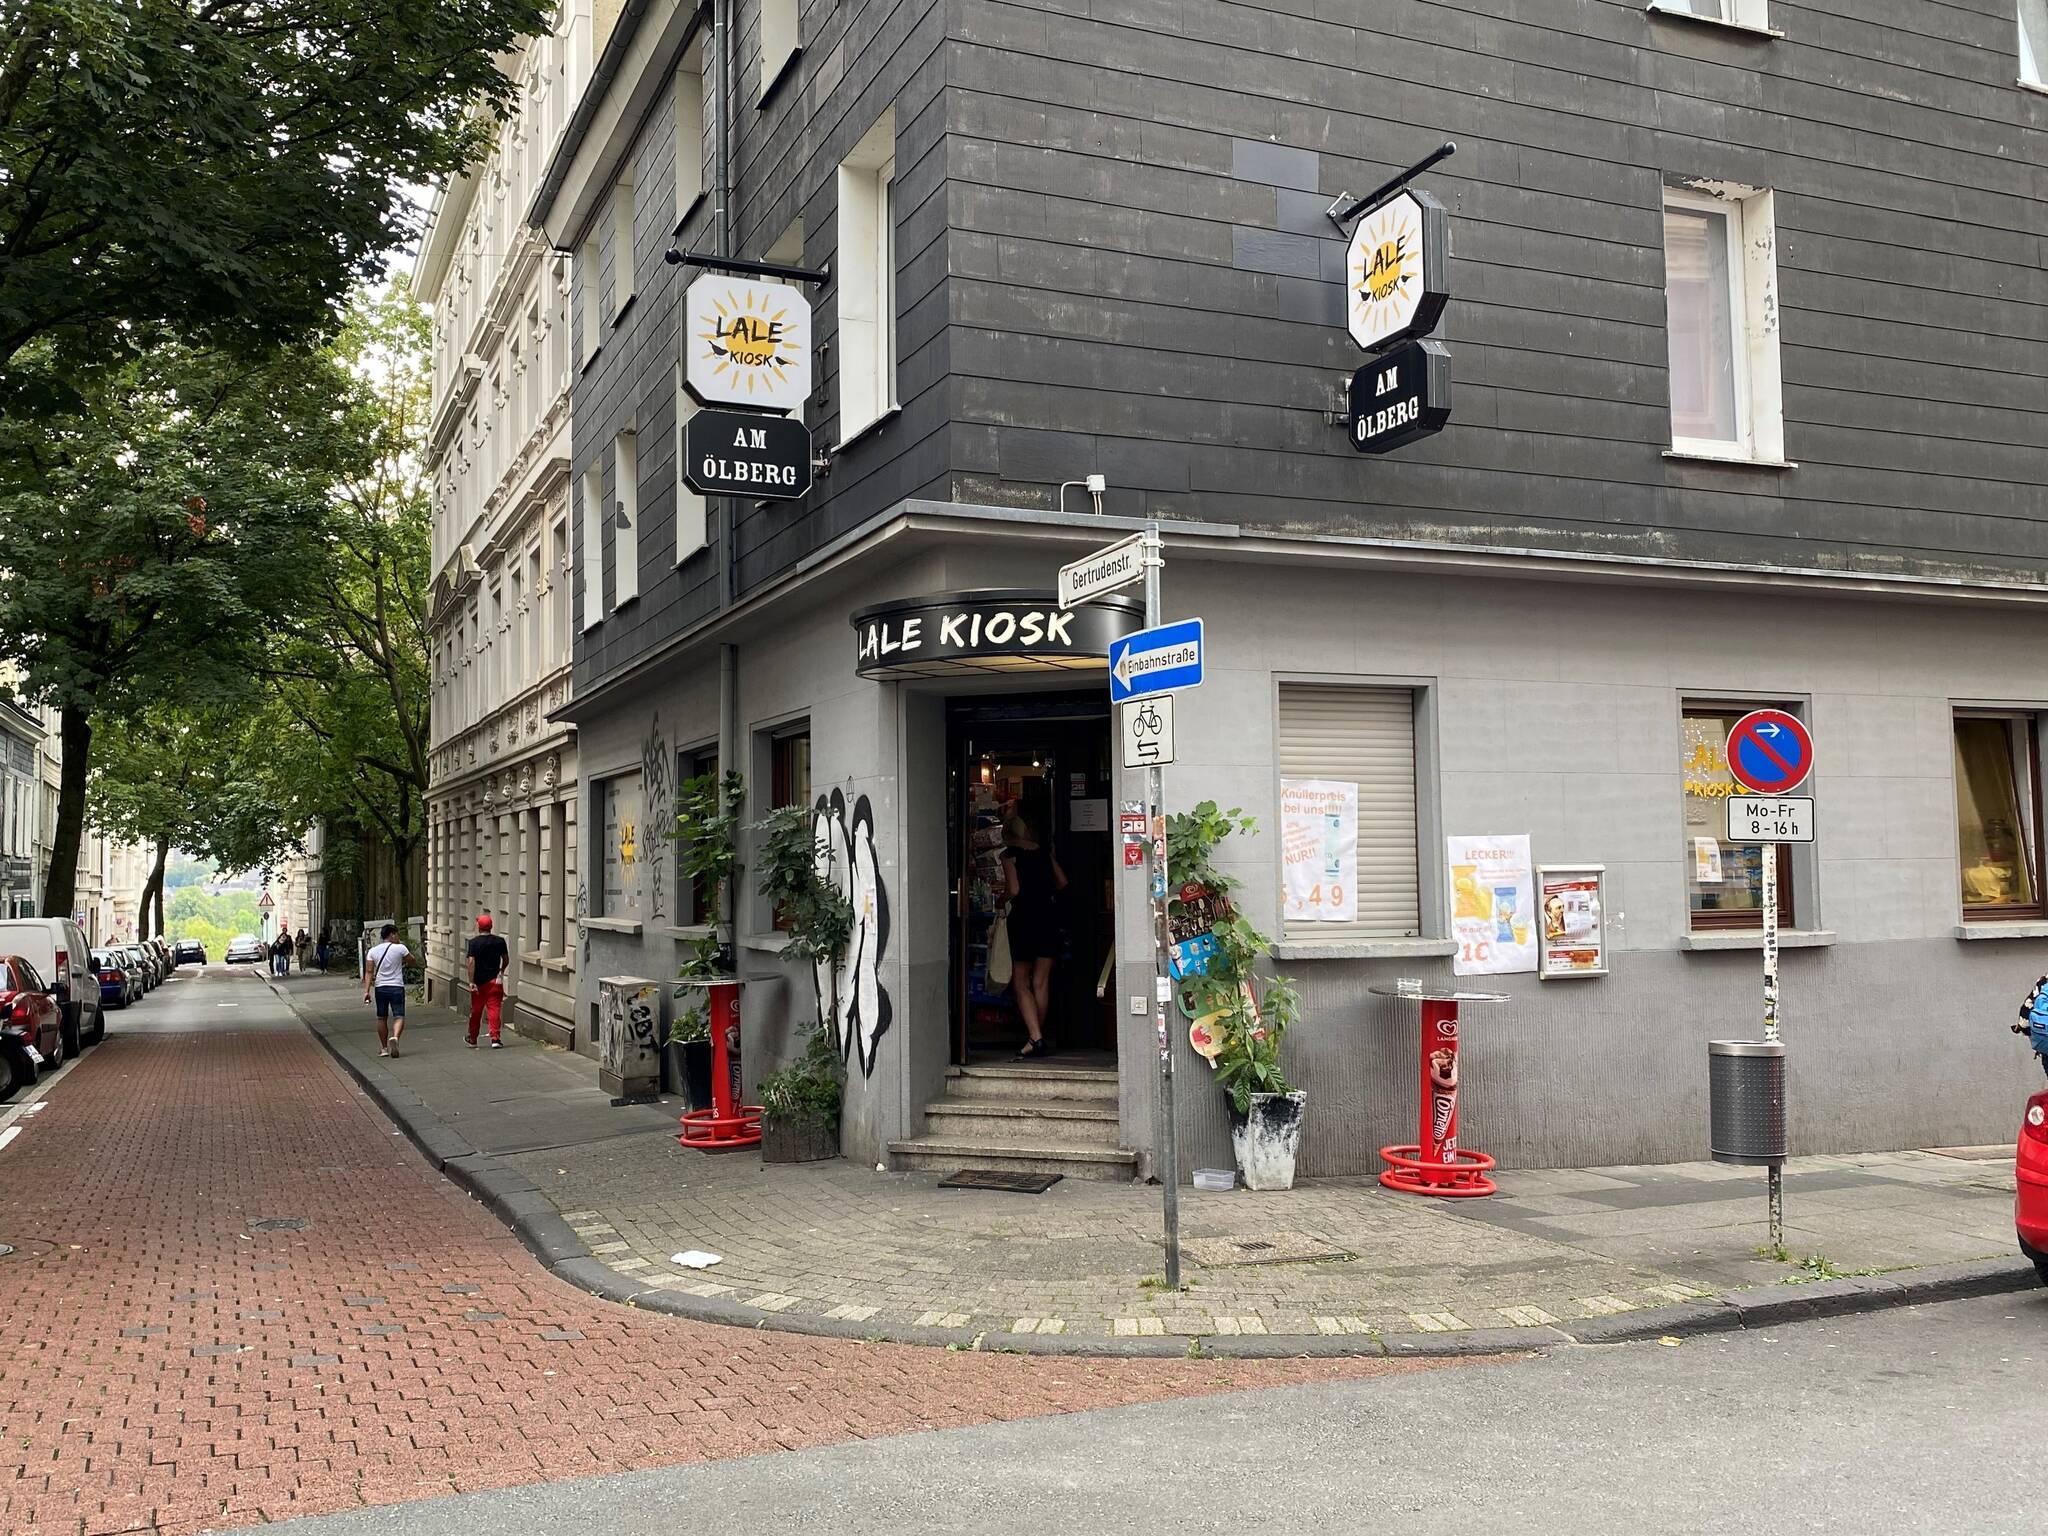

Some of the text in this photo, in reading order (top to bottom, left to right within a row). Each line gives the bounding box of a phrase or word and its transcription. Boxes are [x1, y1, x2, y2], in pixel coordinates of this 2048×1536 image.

[1362, 234, 1406, 284] LALE
[1371, 278, 1400, 303] KIOSK
[716, 314, 783, 344] LALE
[729, 350, 772, 368] KIOSK
[1375, 366, 1398, 396] AM
[1356, 395, 1420, 442] ÖLBERG
[733, 427, 767, 449] AM
[702, 453, 797, 486] ÖLBERG
[1071, 553, 1132, 591] Gertrudenstr.
[858, 611, 1075, 661] LALE KIOSK
[1127, 647, 1196, 675] Einbahnstraße
[1694, 782, 1735, 798] KIOSK
[1746, 803, 1796, 818] Mo-Fr
